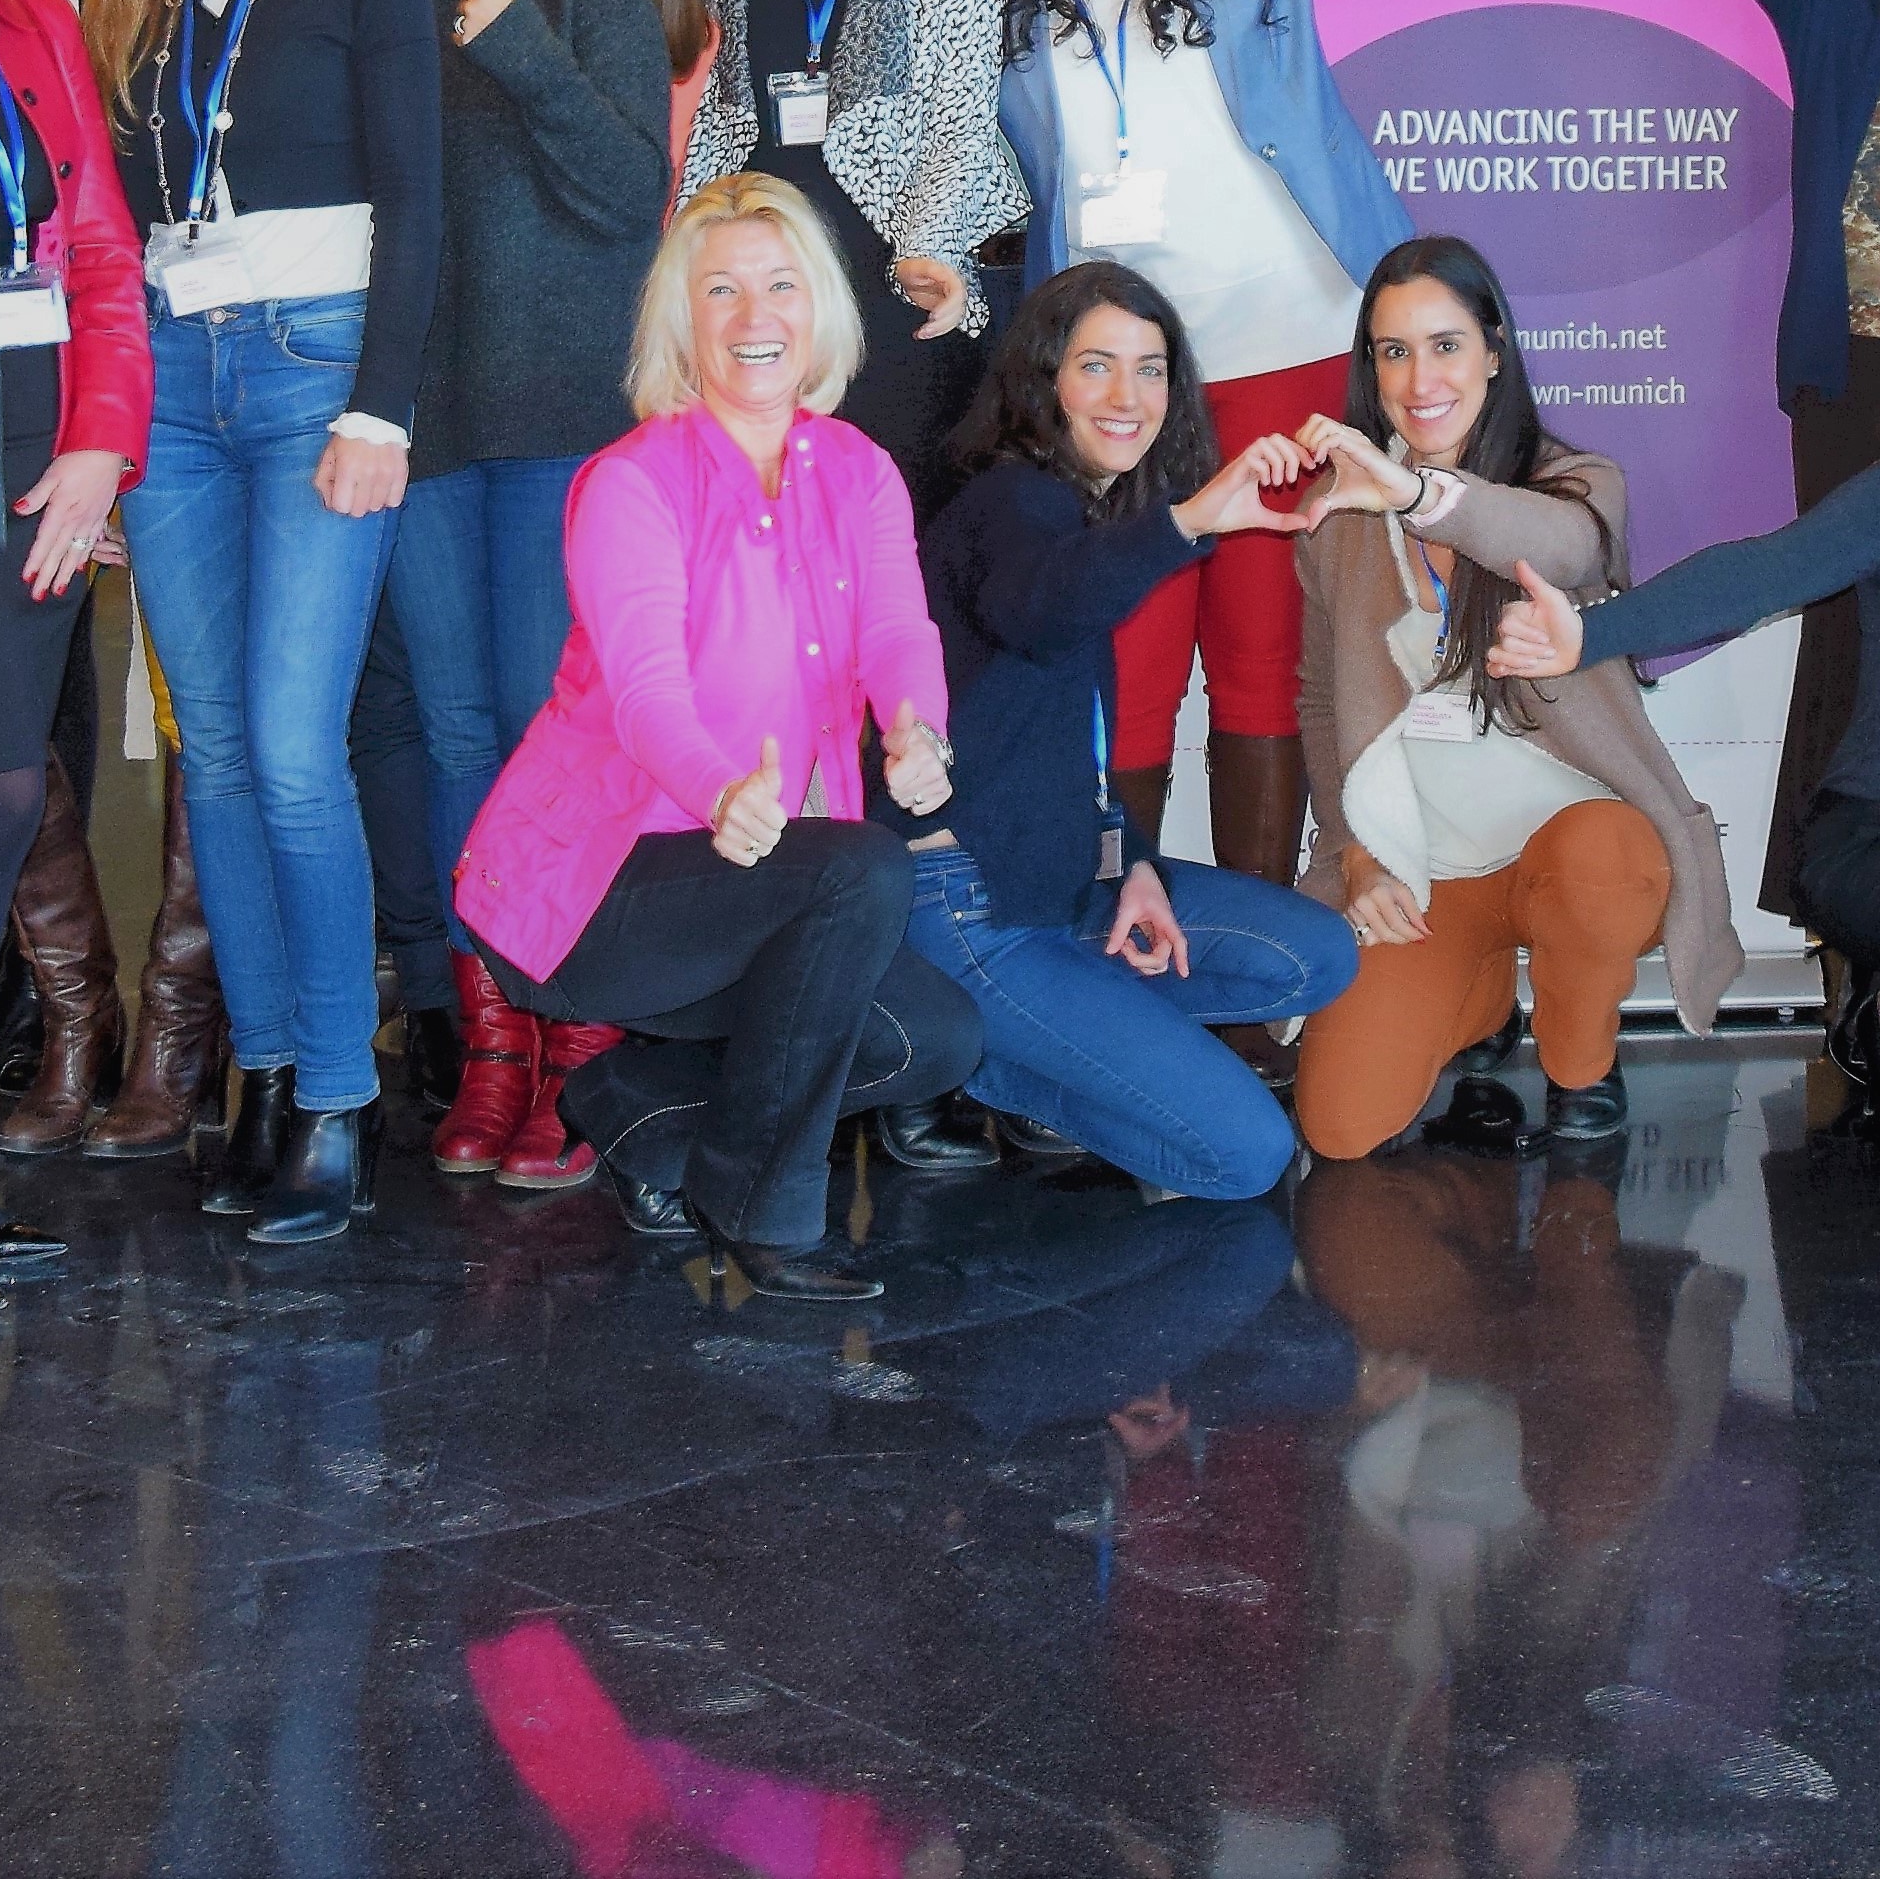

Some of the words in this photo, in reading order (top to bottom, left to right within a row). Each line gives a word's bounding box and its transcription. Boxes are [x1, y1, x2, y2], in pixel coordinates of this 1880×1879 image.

[1373, 109, 1578, 146] ADVANCING
[1587, 108, 1657, 143] THE
[1663, 107, 1740, 143] WAY
[1434, 156, 1540, 192] WORK
[1546, 155, 1728, 192] TOGETHER
